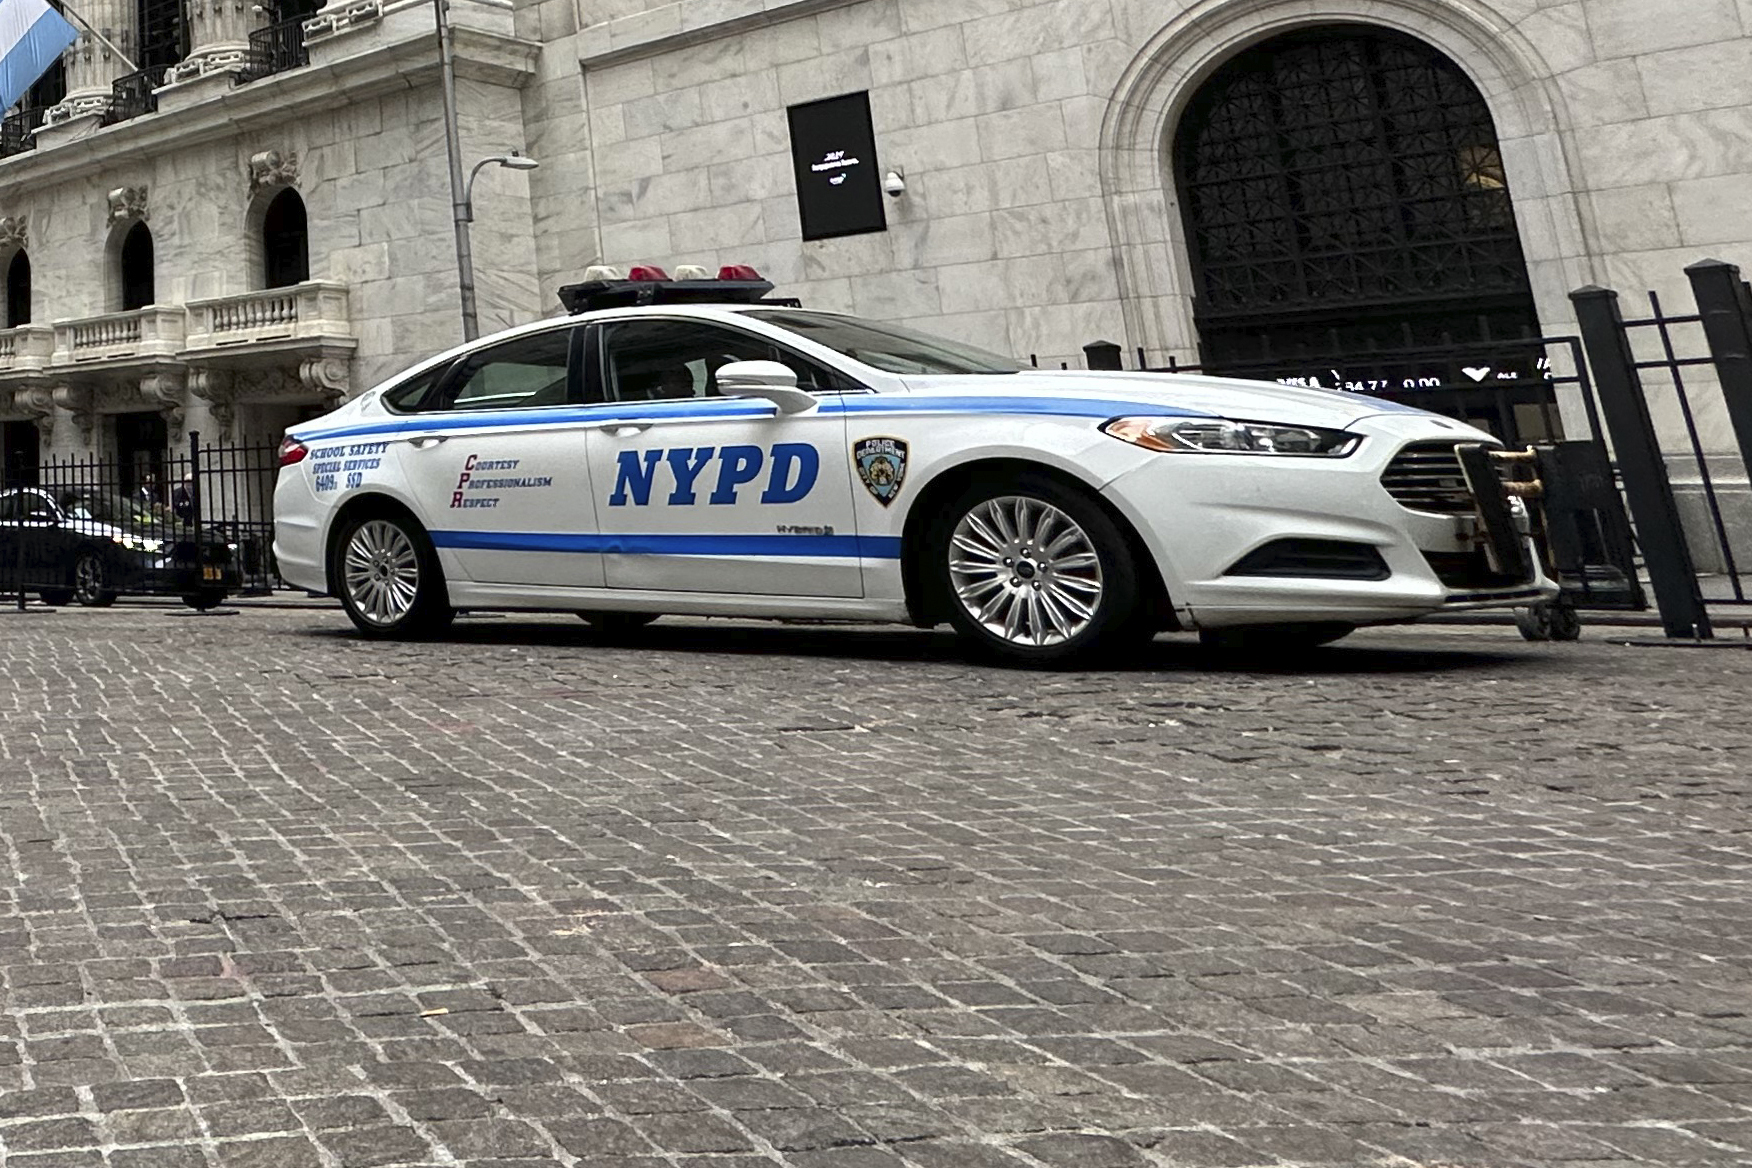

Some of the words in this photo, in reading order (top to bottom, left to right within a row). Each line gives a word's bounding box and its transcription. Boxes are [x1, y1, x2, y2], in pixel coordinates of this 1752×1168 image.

[309, 446, 346, 460] SCHOOL
[348, 442, 390, 456] SAFETY
[313, 461, 342, 474] SPECIAL
[343, 458, 381, 472] SERVICES
[609, 443, 820, 506] NYPD
[457, 473, 553, 490] PROFESSIONALISM
[450, 492, 500, 508] RESPECT
